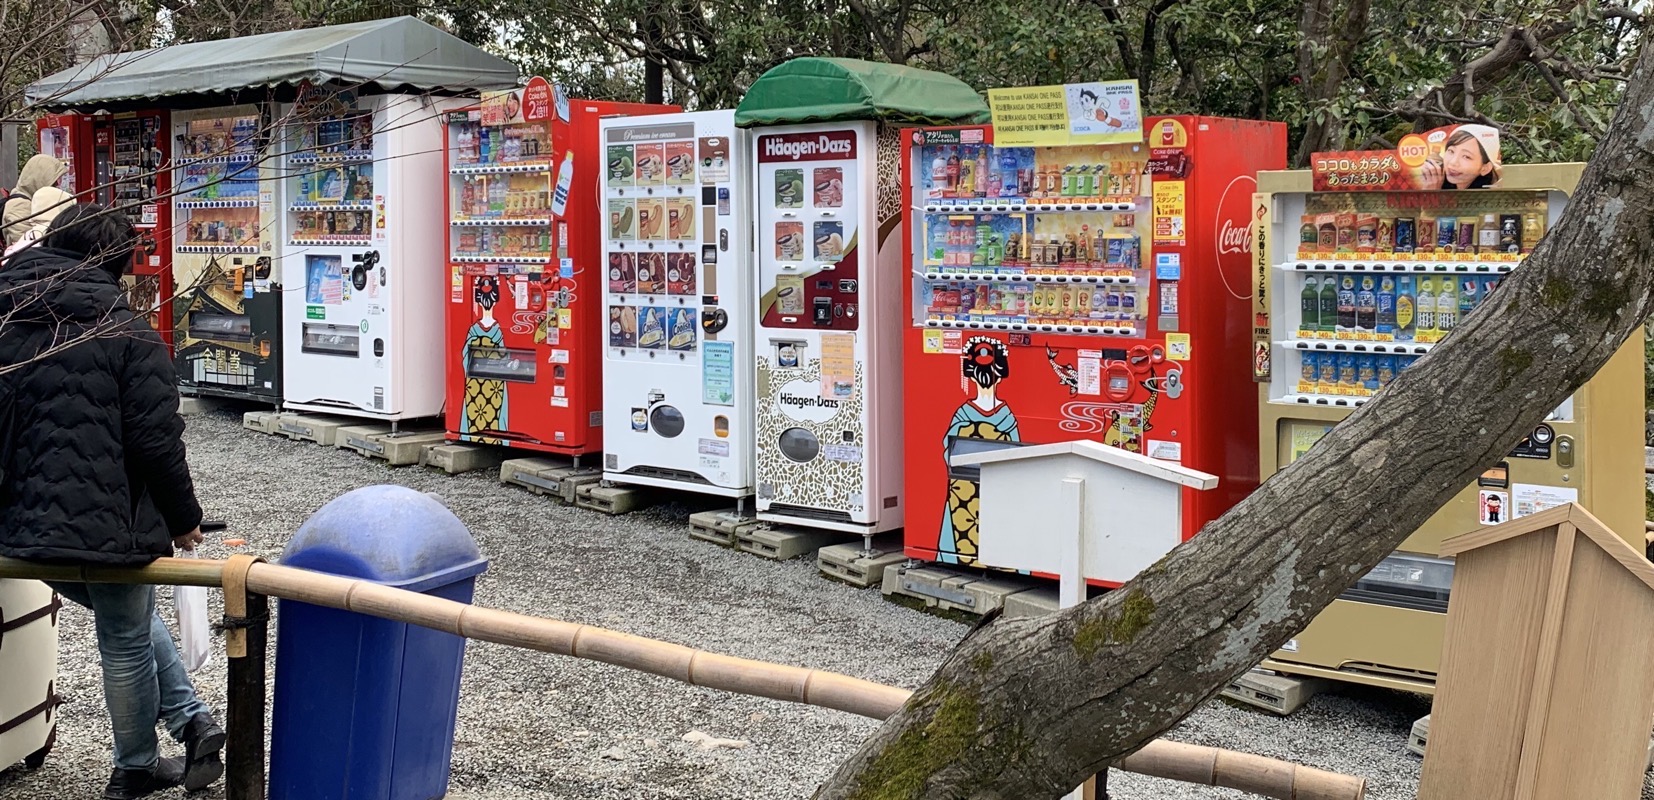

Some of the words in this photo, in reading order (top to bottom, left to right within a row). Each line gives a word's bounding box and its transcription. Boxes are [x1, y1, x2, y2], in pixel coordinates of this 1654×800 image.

[624, 130, 650, 140] Premium
[765, 135, 852, 160] Häagen-Dazs
[1402, 146, 1426, 156] HOT
[1317, 158, 1399, 171] ココロもカラダも
[1219, 219, 1252, 254] Coca-C
[1256, 312, 1269, 327] 新
[780, 392, 839, 409] Häagen-Dazs
